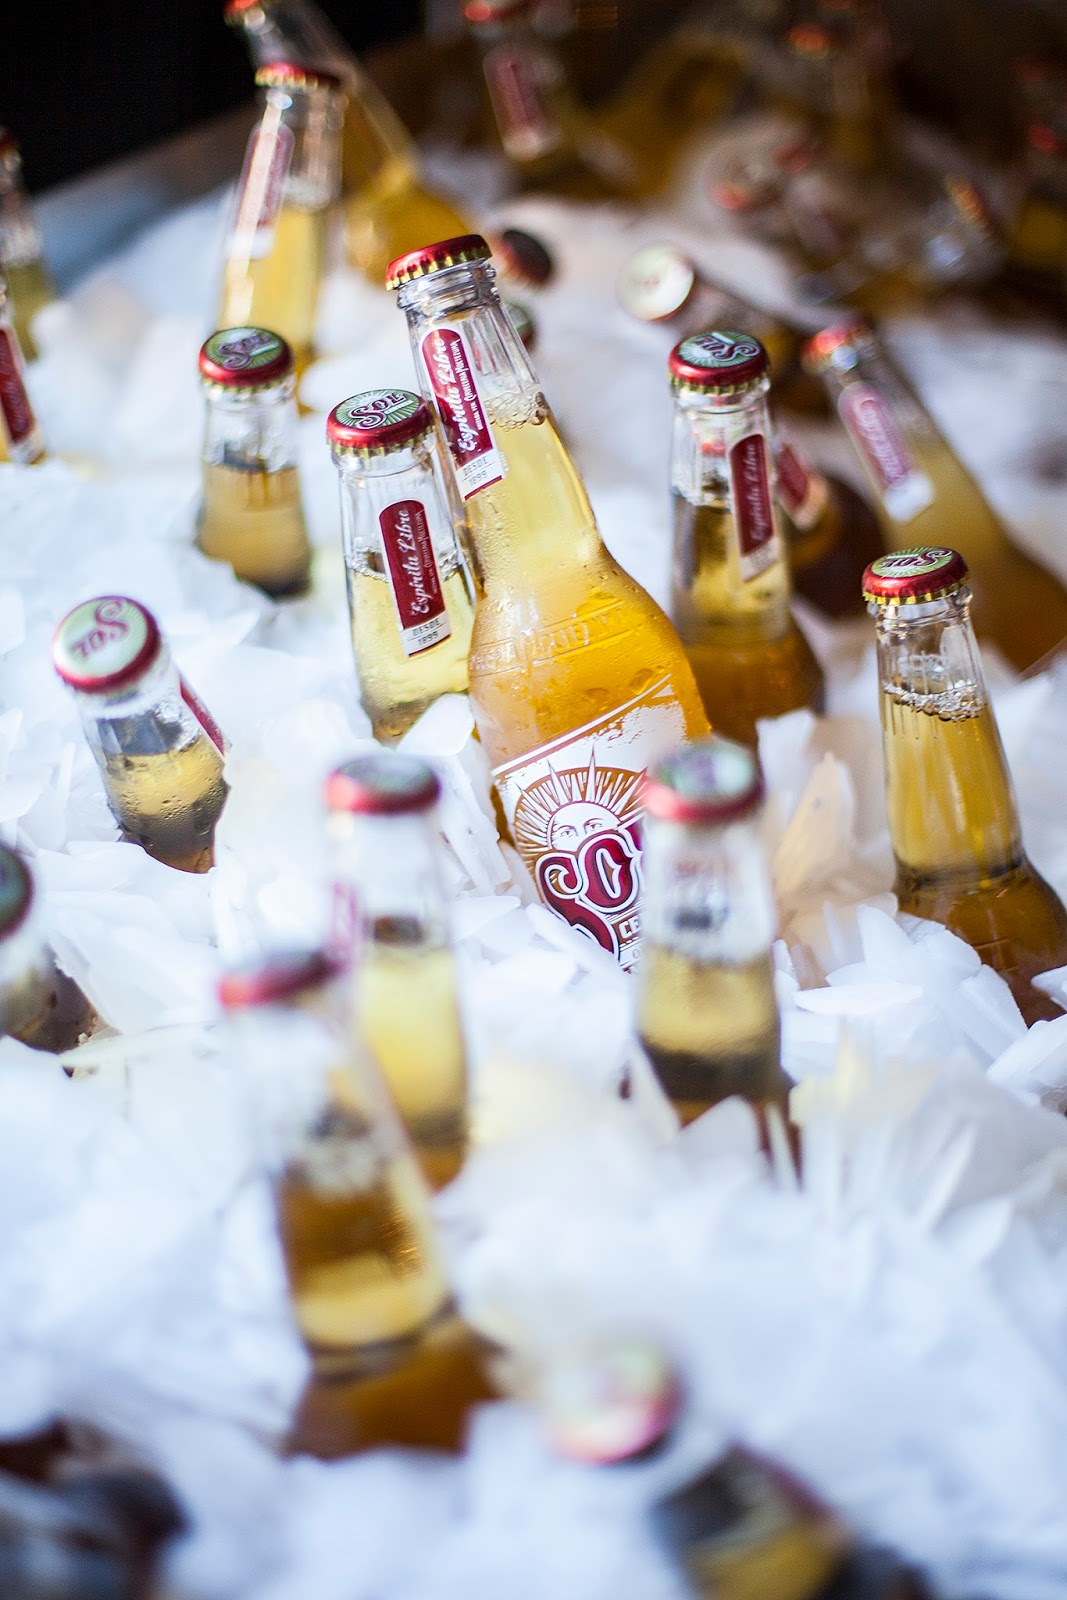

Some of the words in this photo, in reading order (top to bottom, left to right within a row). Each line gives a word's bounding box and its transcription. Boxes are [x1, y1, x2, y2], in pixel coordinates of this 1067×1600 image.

[433, 338, 456, 386] Libre
[348, 392, 407, 430] SOL
[463, 456, 488, 476] DESDE
[468, 470, 488, 486] 1899
[395, 509, 417, 552] Libre
[71, 599, 128, 658] SOL
[412, 617, 441, 637] DESDE
[417, 630, 439, 647] 1899
